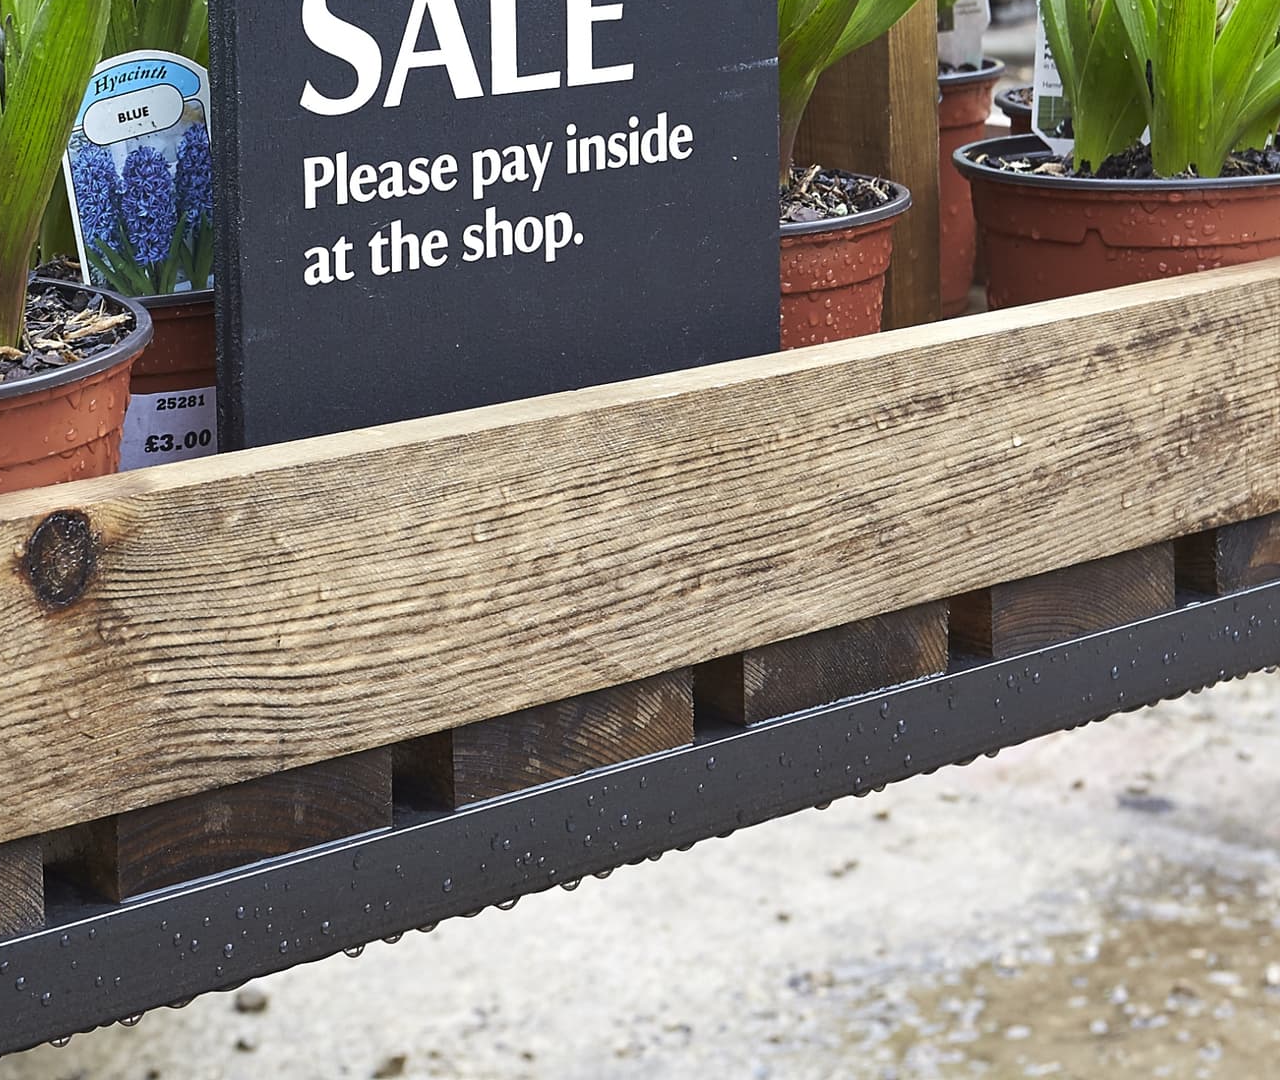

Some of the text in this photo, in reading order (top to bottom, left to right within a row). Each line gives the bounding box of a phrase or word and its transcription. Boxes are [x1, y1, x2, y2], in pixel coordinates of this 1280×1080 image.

[94, 65, 167, 97] Hyacinth
[117, 106, 150, 124] BLUE
[303, 112, 694, 210] Please pay inside
[303, 206, 585, 286] at the shop.
[156, 394, 205, 411] 25281
[144, 428, 212, 453] £3.00
